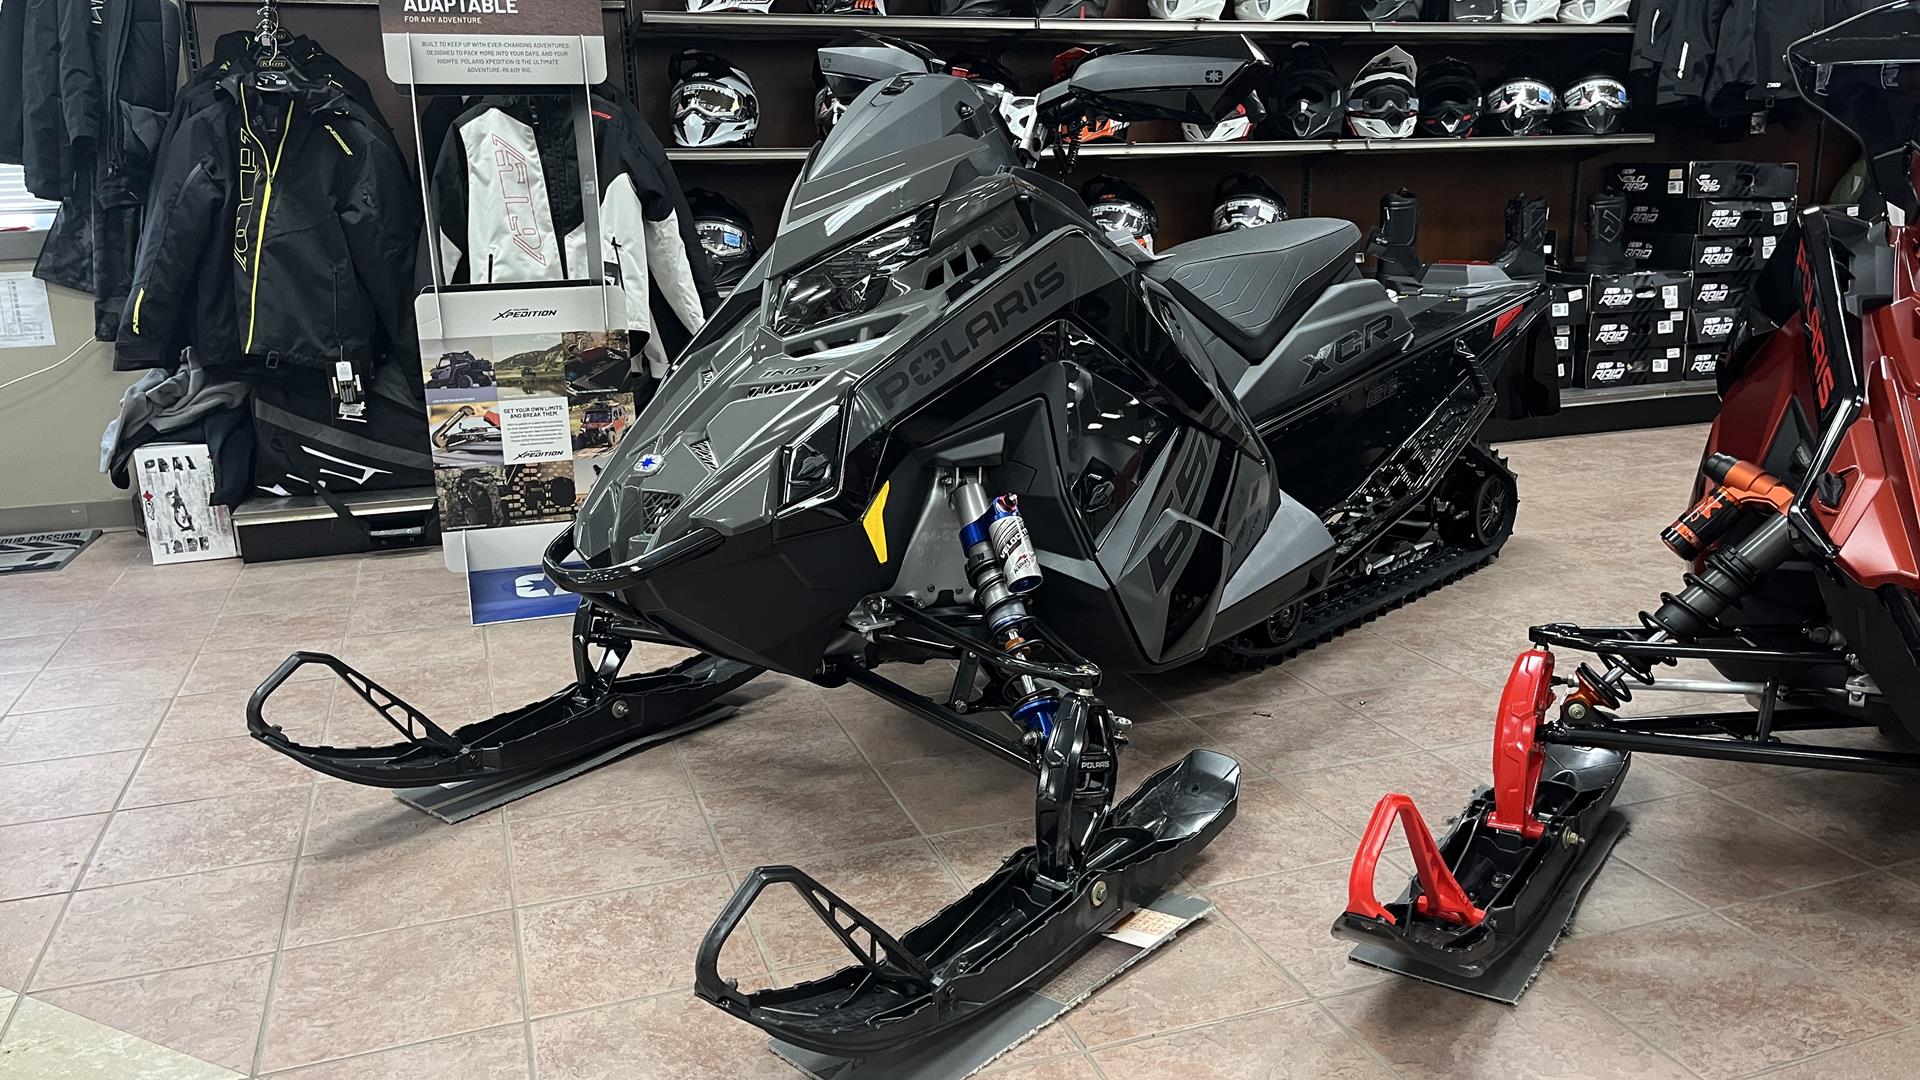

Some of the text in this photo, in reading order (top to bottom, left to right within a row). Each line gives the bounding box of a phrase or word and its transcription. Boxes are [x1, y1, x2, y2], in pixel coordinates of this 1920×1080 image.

[403, 0, 519, 14] ADAPTABLE
[404, 15, 482, 24] FOR ANY ADVENTURE
[1623, 182, 1649, 192] RAID
[1629, 212, 1659, 223] RAID
[1707, 216, 1741, 229] RAID
[1699, 252, 1734, 265] RAID
[1598, 294, 1634, 306] RAID
[1697, 290, 1729, 302] RAID
[492, 309, 558, 321] XPEDITION
[1701, 323, 1734, 336] RAID
[1795, 238, 1835, 410] POLARIS
[875, 260, 1067, 412] POLARIS
[1595, 330, 1629, 343] RAID
[1299, 313, 1395, 389] XCR
[758, 364, 828, 379] INDY
[1691, 361, 1716, 373] RAI
[1591, 368, 1626, 381] RAID
[513, 450, 564, 461] XPEDITION
[27, 532, 82, 543] PASSION
[1081, 760, 1110, 769] POLARIS
